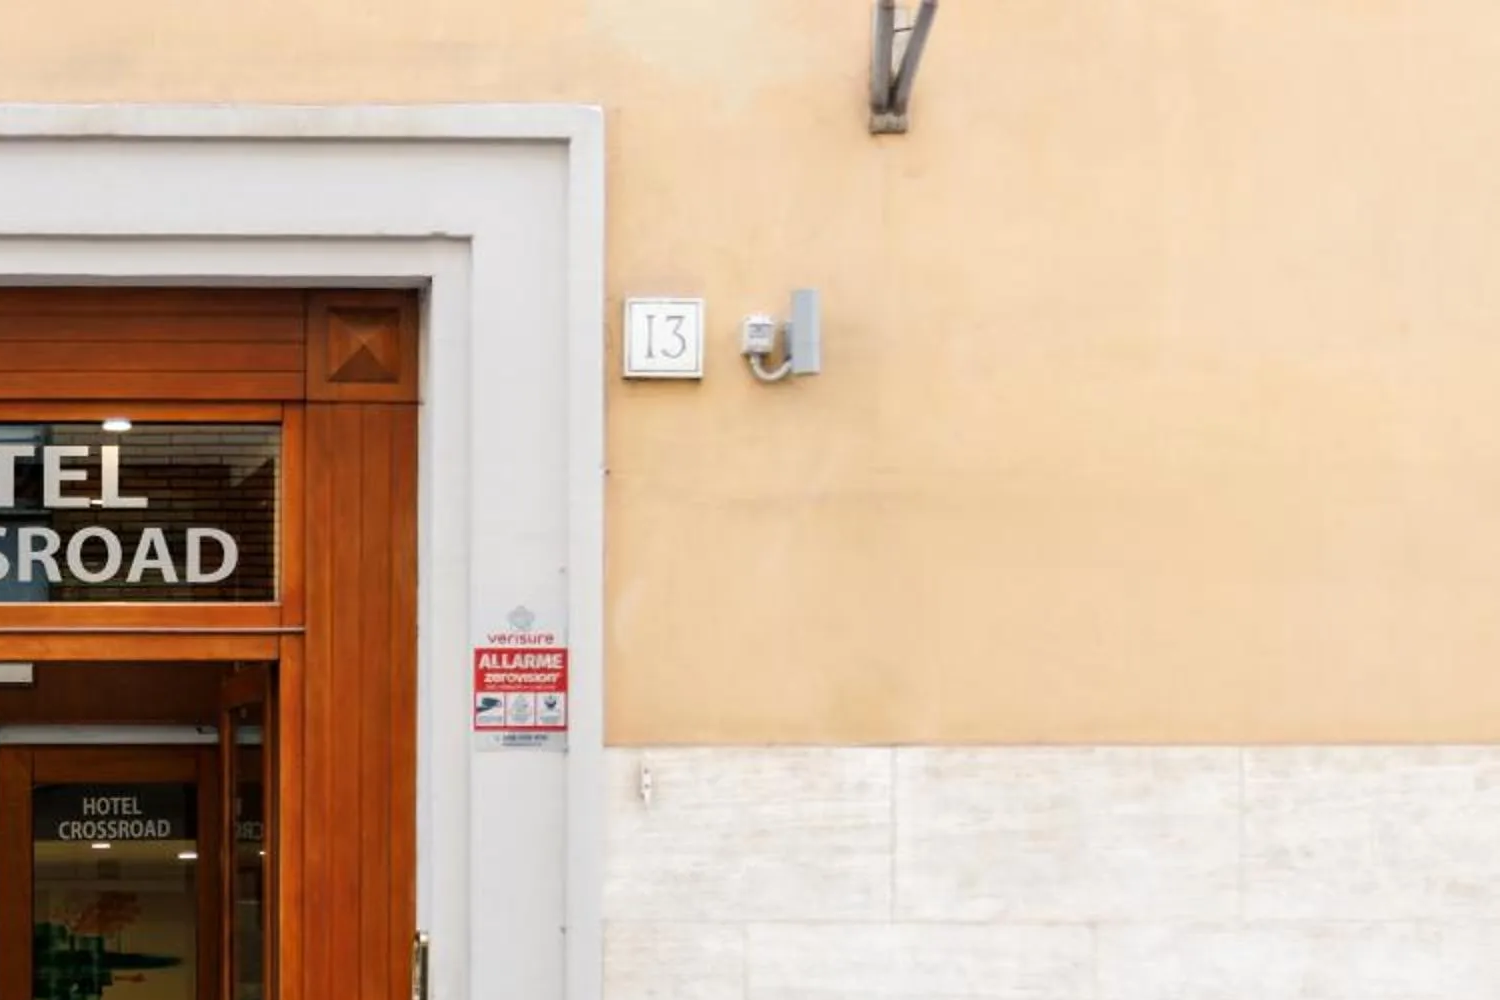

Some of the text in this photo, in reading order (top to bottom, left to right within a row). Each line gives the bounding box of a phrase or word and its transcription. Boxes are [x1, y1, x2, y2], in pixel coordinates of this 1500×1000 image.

[644, 314, 687, 360] 13
[487, 633, 555, 645] verisure
[479, 653, 564, 669] ALLARME
[82, 797, 143, 817] HOTEL
[58, 820, 171, 840] CROSSROAD
